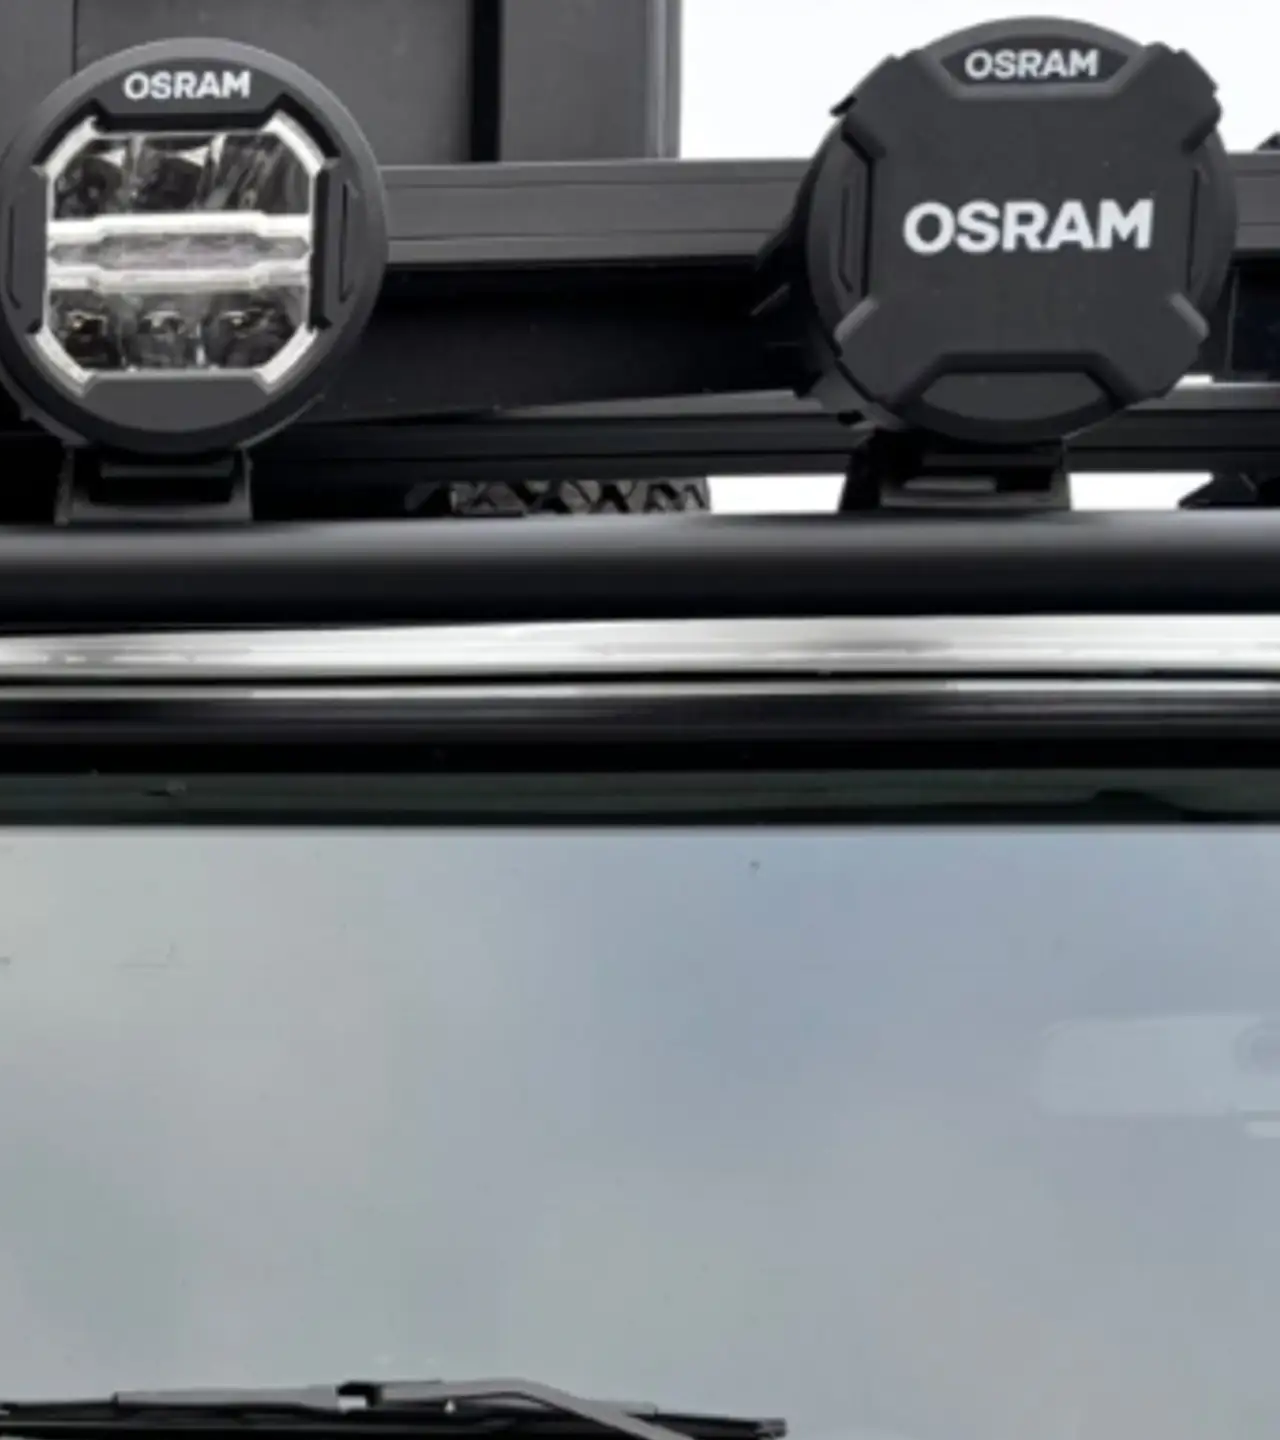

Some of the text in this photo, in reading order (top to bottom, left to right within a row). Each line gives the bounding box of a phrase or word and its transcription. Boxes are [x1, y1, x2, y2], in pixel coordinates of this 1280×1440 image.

[963, 47, 1100, 80] OSRAM
[122, 69, 252, 101] OSRAM
[902, 198, 1155, 255] OSRAM
